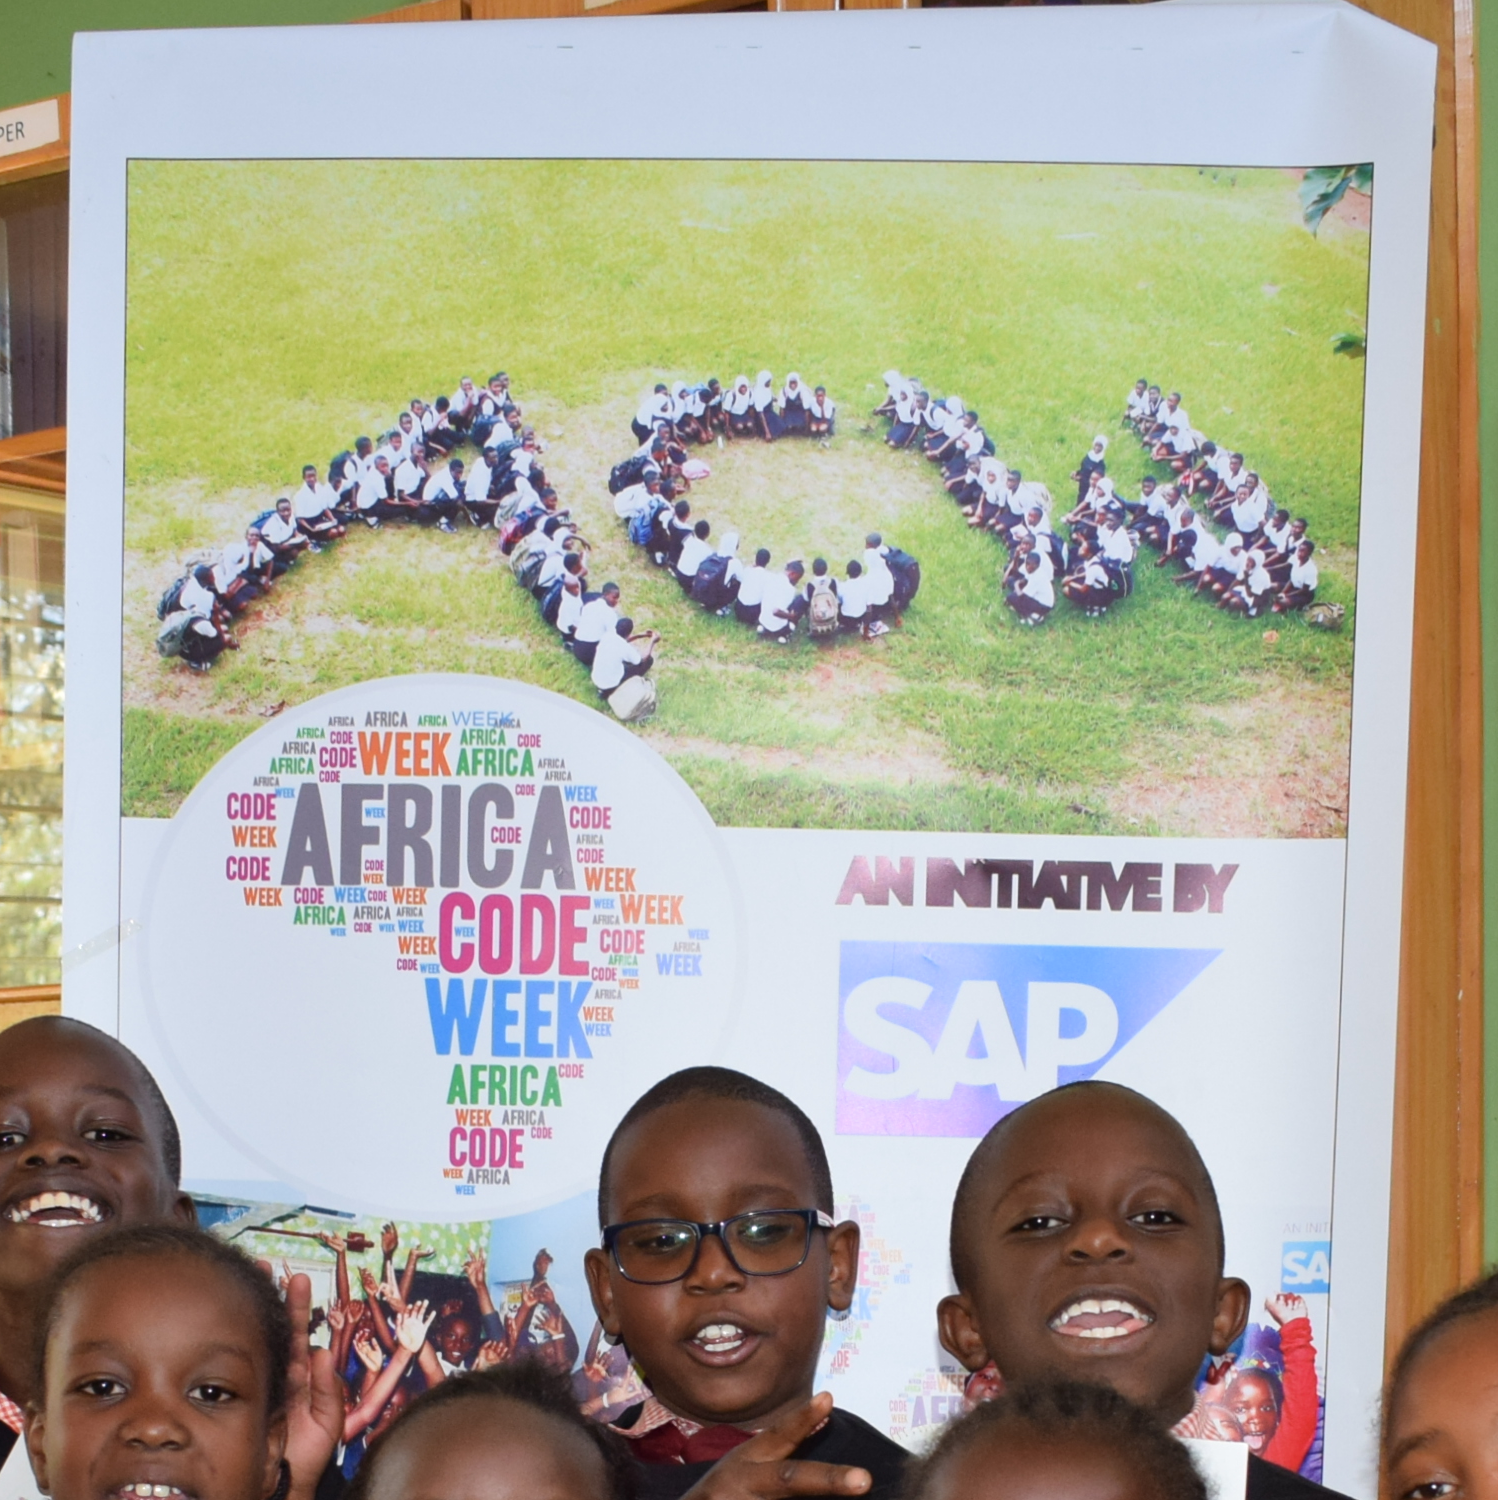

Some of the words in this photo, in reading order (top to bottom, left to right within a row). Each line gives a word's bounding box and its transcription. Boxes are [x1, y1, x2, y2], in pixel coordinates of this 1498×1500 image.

[365, 711, 408, 727] AFRICA
[270, 758, 314, 774] AFRICA
[320, 747, 357, 768] CODE
[358, 732, 452, 776] WEEK
[456, 749, 534, 776] AFRICA
[227, 792, 276, 820] CODE
[564, 786, 597, 802] WEEK
[570, 806, 611, 829] CODE
[232, 826, 276, 847] WEEK
[281, 782, 576, 890] AFRICA
[226, 856, 270, 880] CODE
[585, 868, 636, 892] WEEK
[244, 887, 282, 906] WEEK
[835, 855, 914, 907] AN
[925, 856, 1162, 913] INITIATIVE
[1173, 863, 1240, 914] BY
[293, 906, 346, 925] AFRICA
[620, 894, 684, 925] WEEK
[439, 891, 591, 976] CODE
[600, 929, 644, 954] CODE
[424, 978, 593, 1058] WEEK
[842, 975, 1119, 1101] SAP
[446, 1064, 562, 1107] AFRICA
[449, 1127, 524, 1168] CODE
